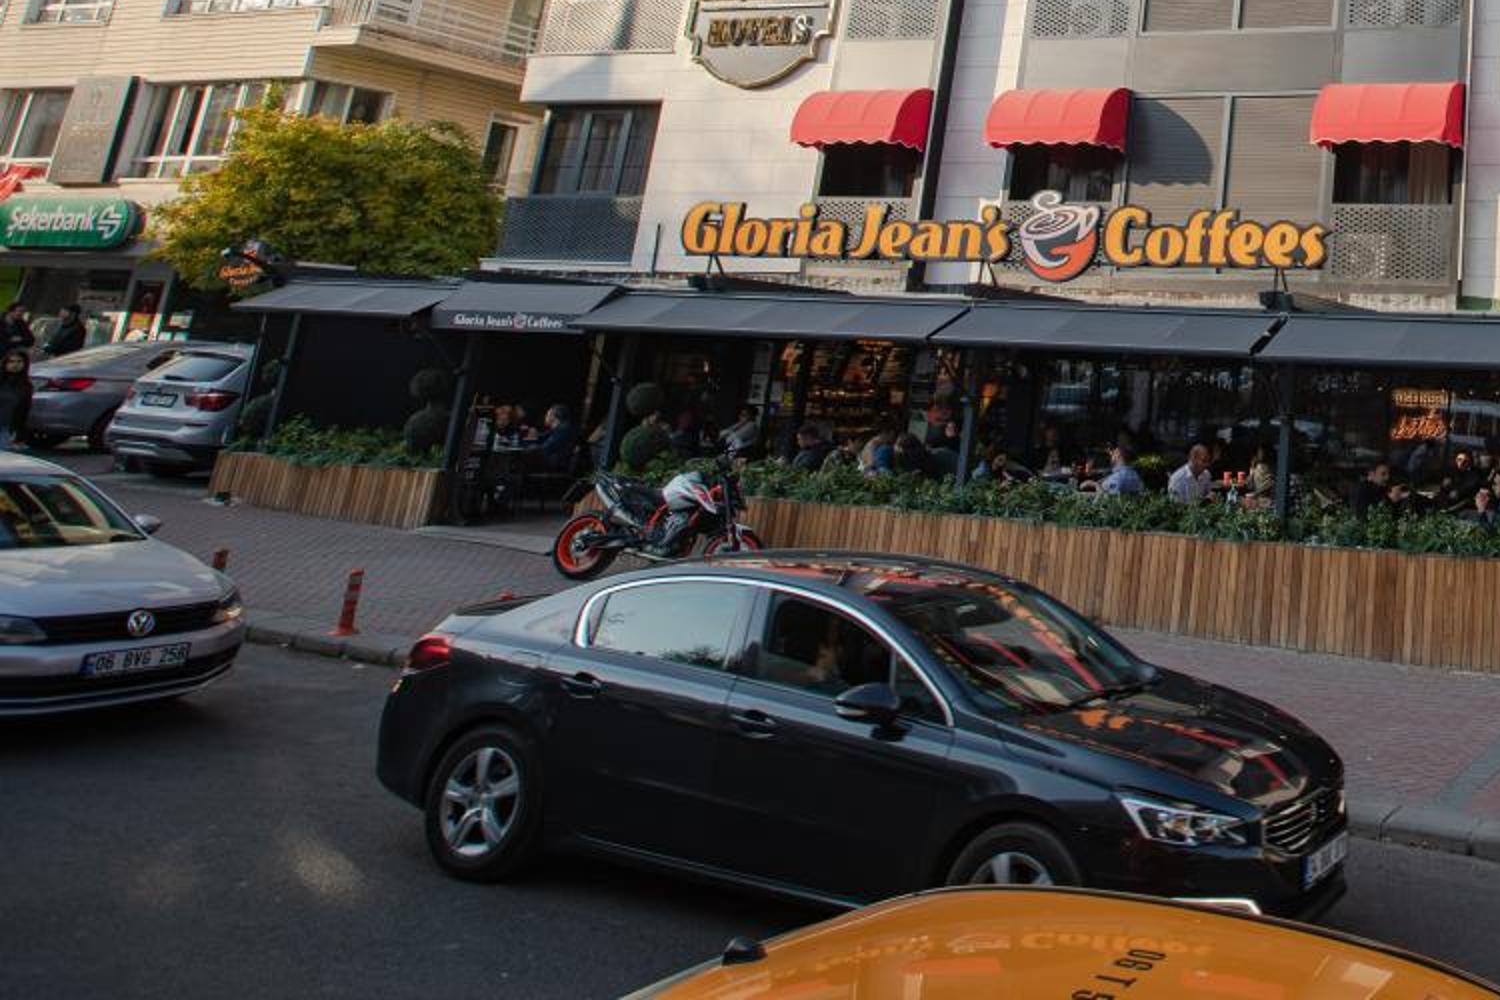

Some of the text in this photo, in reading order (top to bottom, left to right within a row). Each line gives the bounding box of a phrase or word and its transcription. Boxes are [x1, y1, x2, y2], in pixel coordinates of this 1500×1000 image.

[681, 200, 1331, 269] Gloria Jean's Coffees
[1112, 948, 1168, 972] 06
